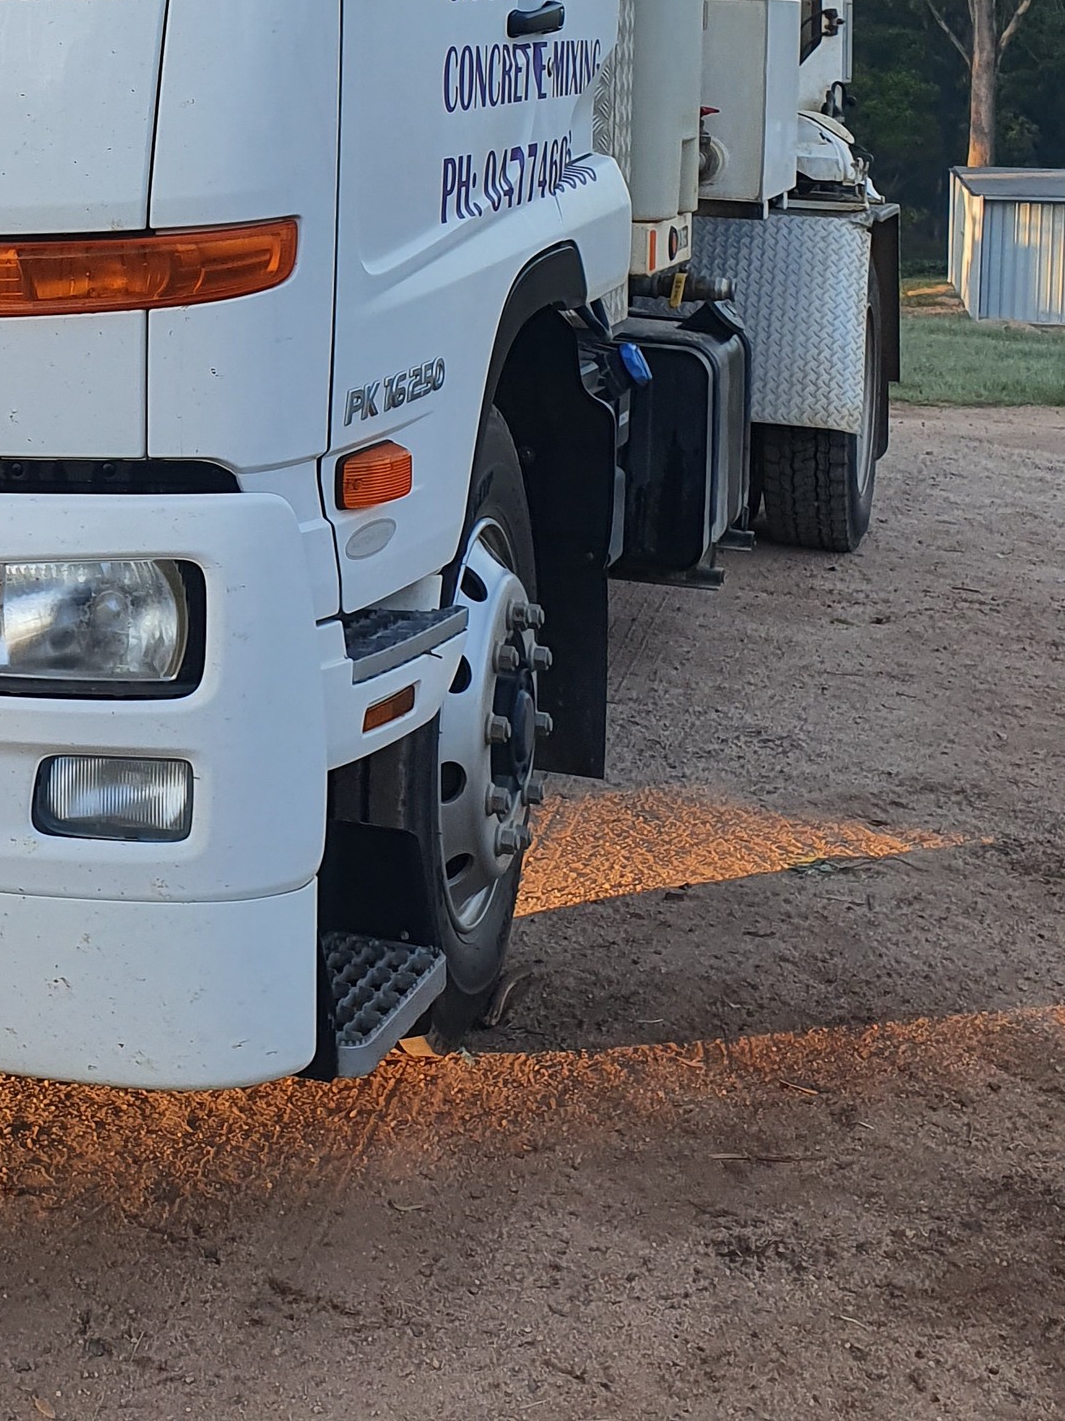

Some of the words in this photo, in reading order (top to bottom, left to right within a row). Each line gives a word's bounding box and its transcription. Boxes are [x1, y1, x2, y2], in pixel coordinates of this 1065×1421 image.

[443, 41, 548, 113] CONCRETE
[552, 38, 602, 99] MIXING
[343, 379, 381, 428] PK
[383, 355, 446, 413] 16250
